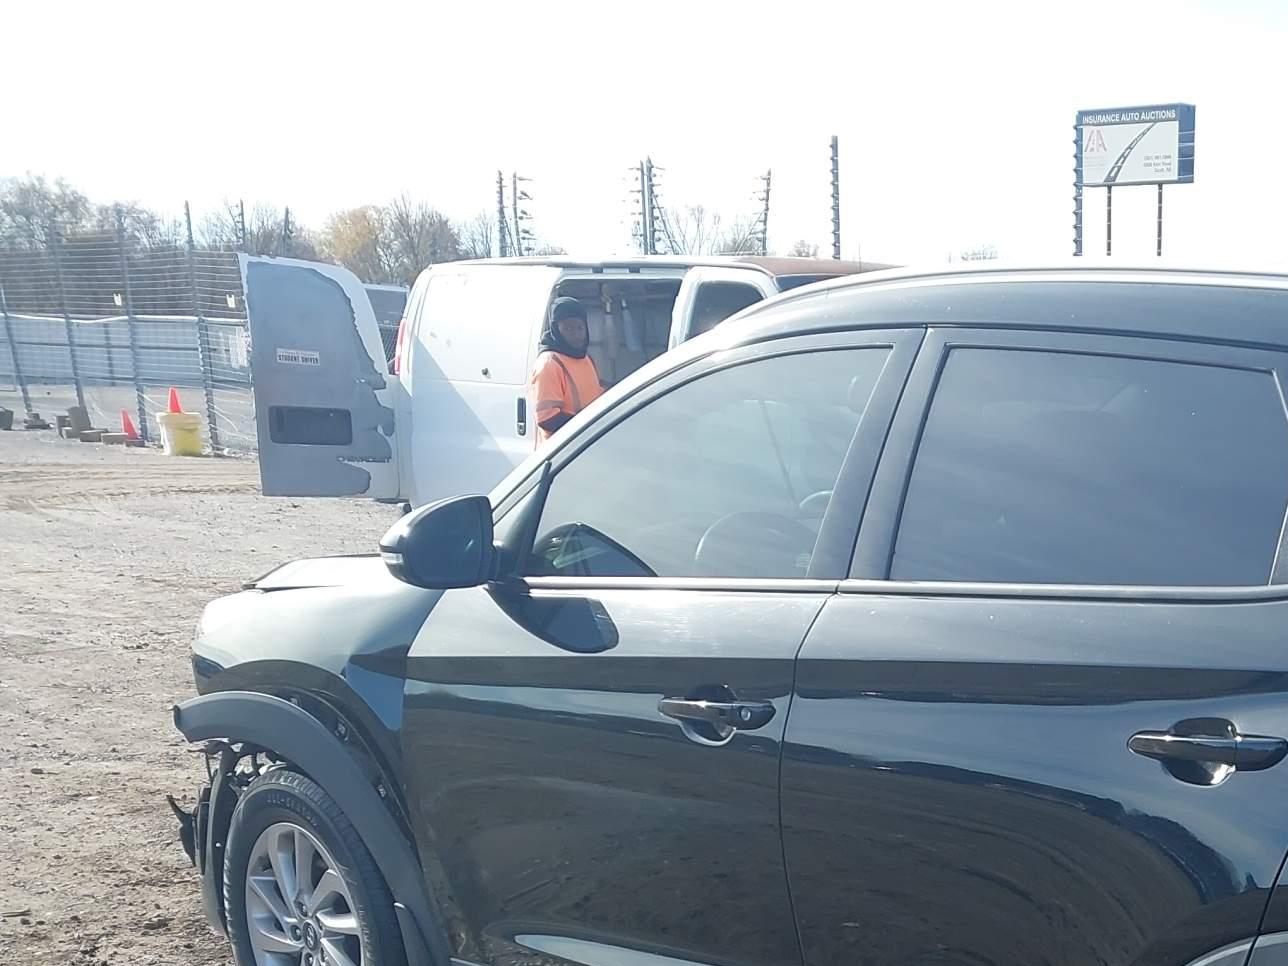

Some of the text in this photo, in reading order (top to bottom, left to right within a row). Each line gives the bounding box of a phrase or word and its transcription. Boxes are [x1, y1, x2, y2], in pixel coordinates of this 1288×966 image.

[1082, 109, 1176, 124] INSURANCE AUTO AUCTIONS
